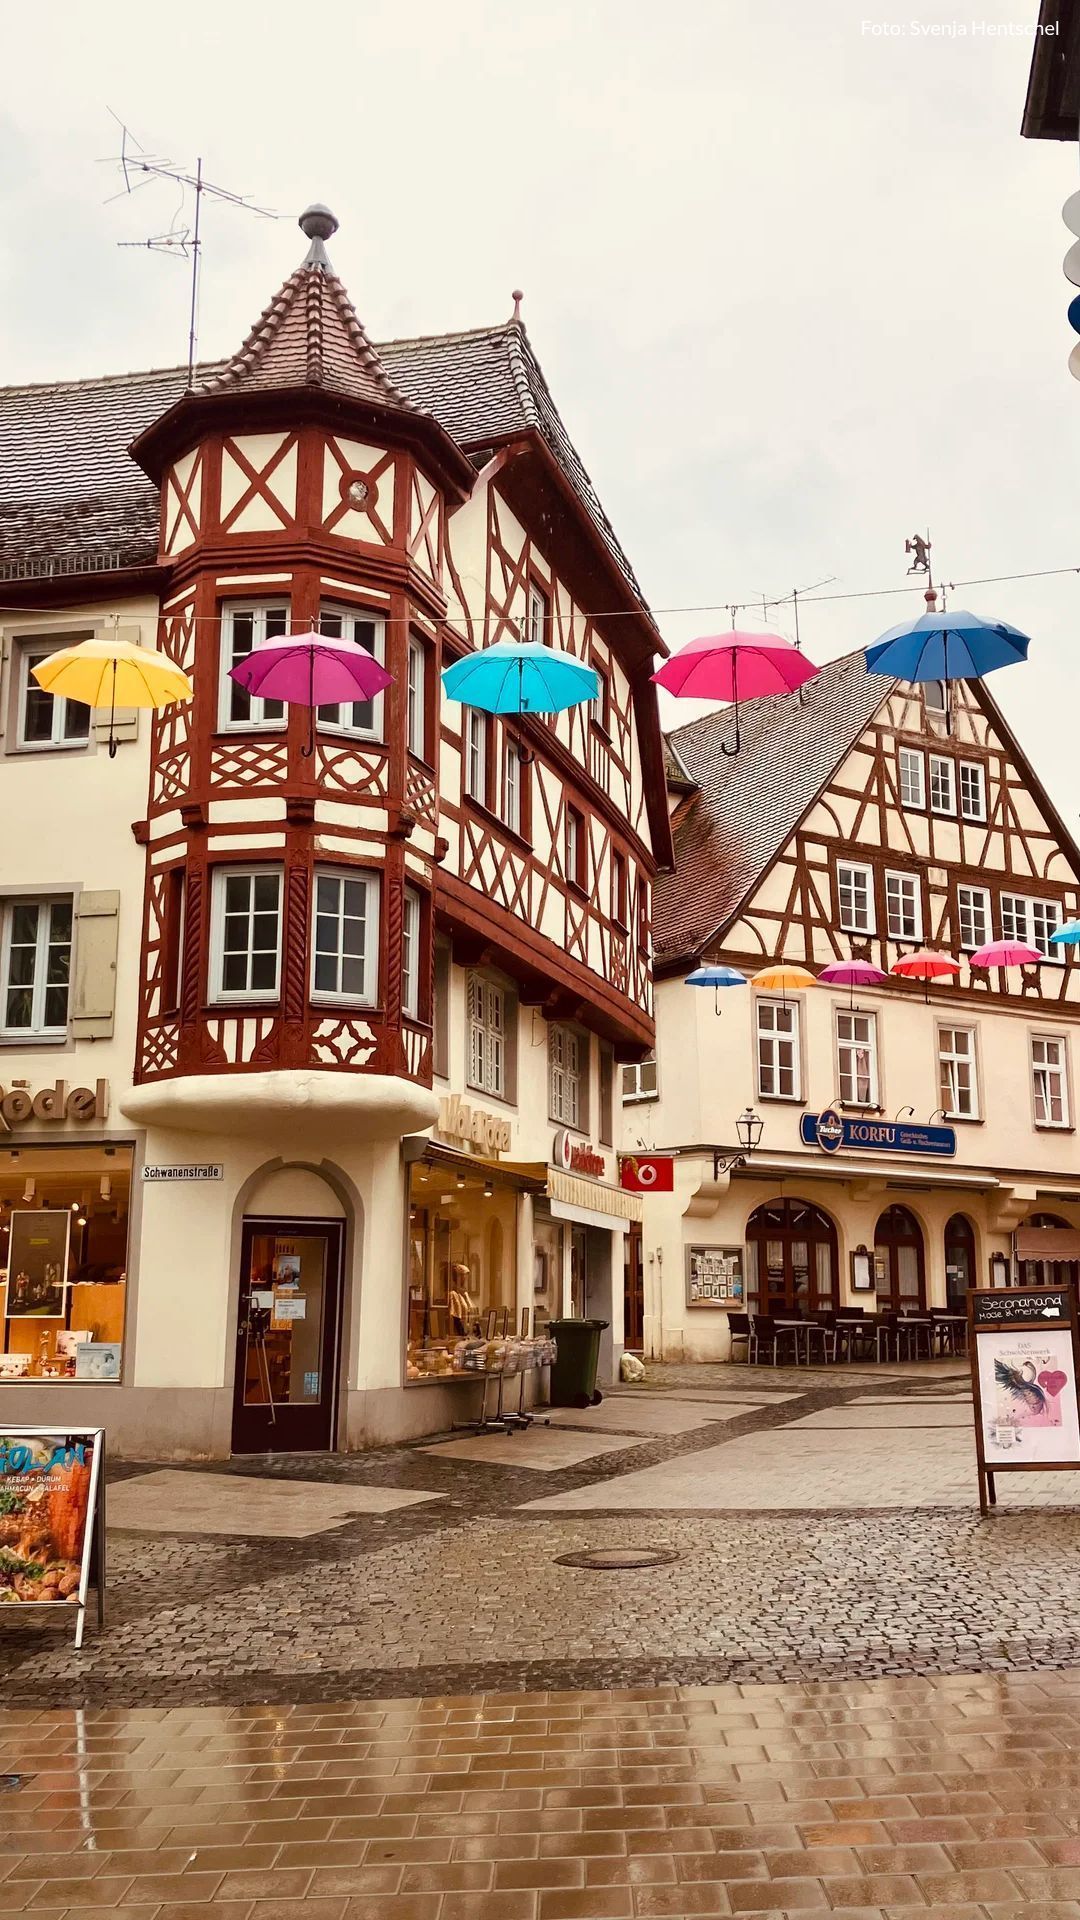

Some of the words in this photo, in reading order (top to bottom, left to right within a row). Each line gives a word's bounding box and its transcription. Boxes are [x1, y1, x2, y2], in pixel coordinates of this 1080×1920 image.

[818, 1124, 842, 1135] Tucher
[850, 1124, 896, 1143] KORFU
[144, 1166, 219, 1179] Schwanenstraße
[981, 1294, 1062, 1311] Secondhand
